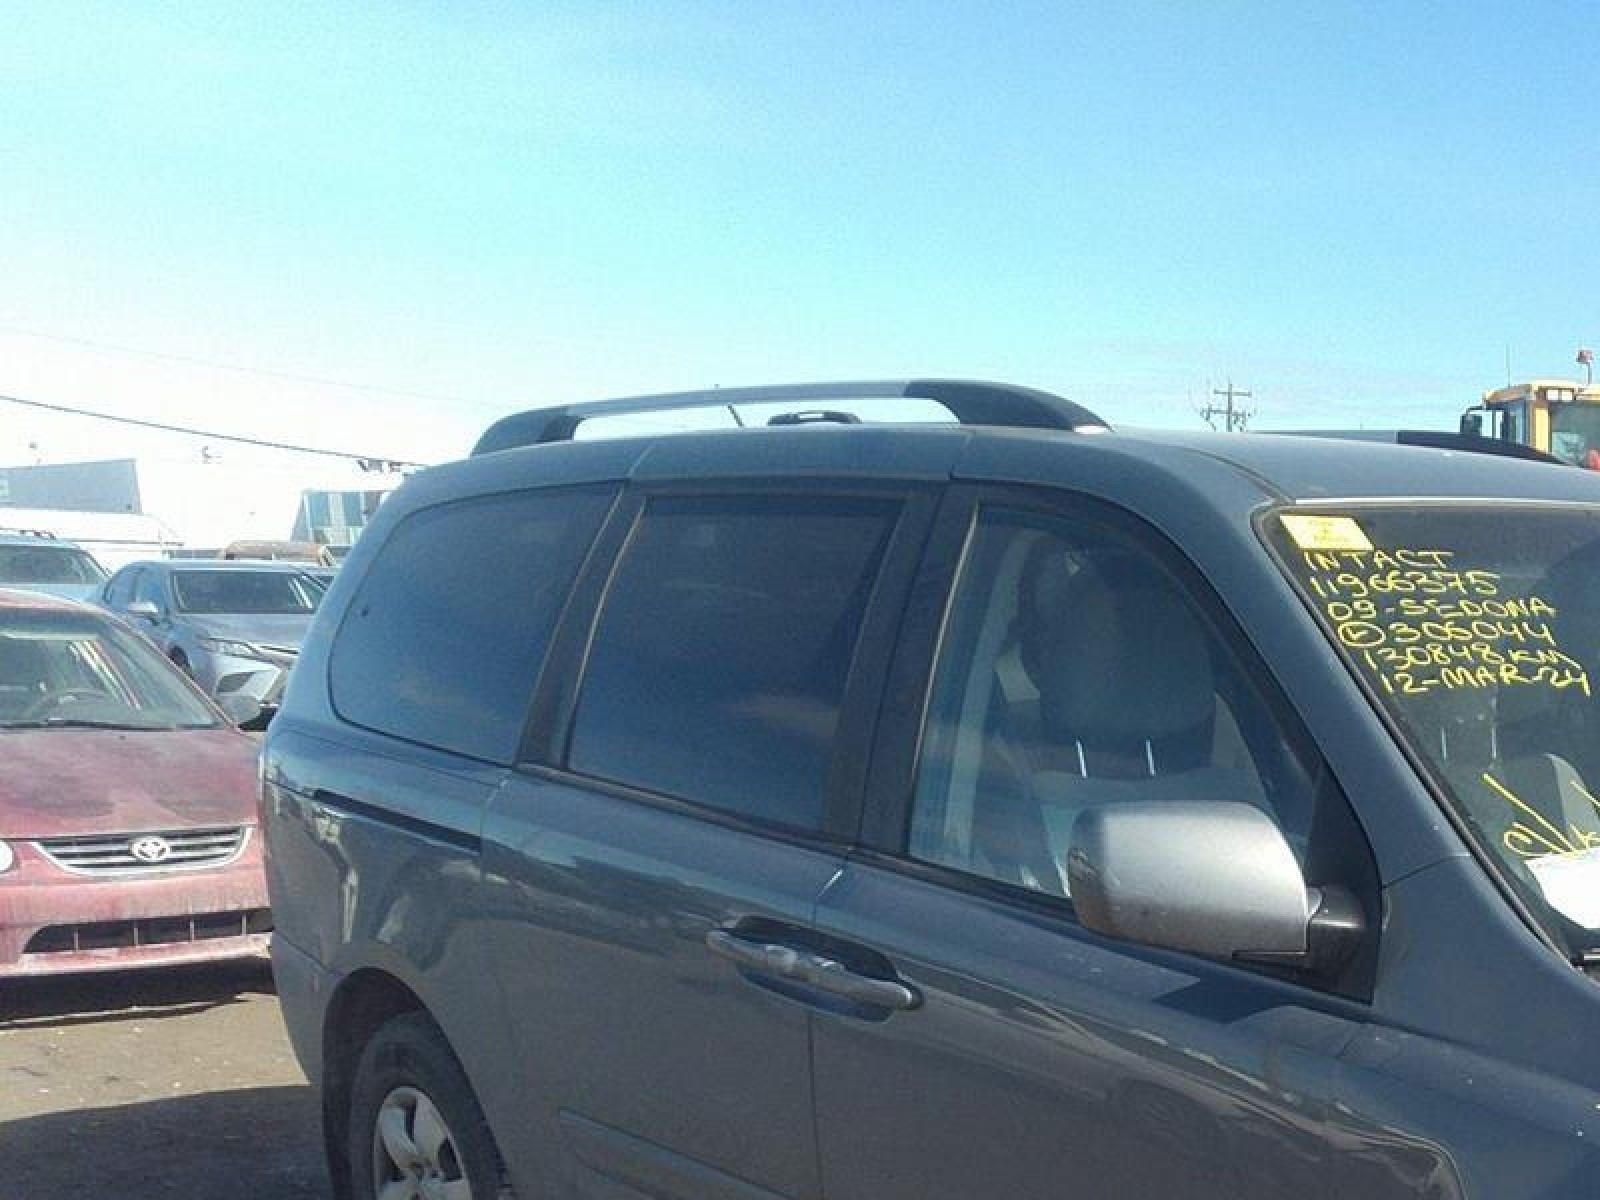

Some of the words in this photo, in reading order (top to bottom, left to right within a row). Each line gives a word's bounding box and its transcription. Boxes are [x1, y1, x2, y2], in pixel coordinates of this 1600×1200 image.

[1303, 550, 1454, 571] INTACT
[1311, 571, 1500, 598] 11966375
[1388, 621, 1556, 646] 306044
